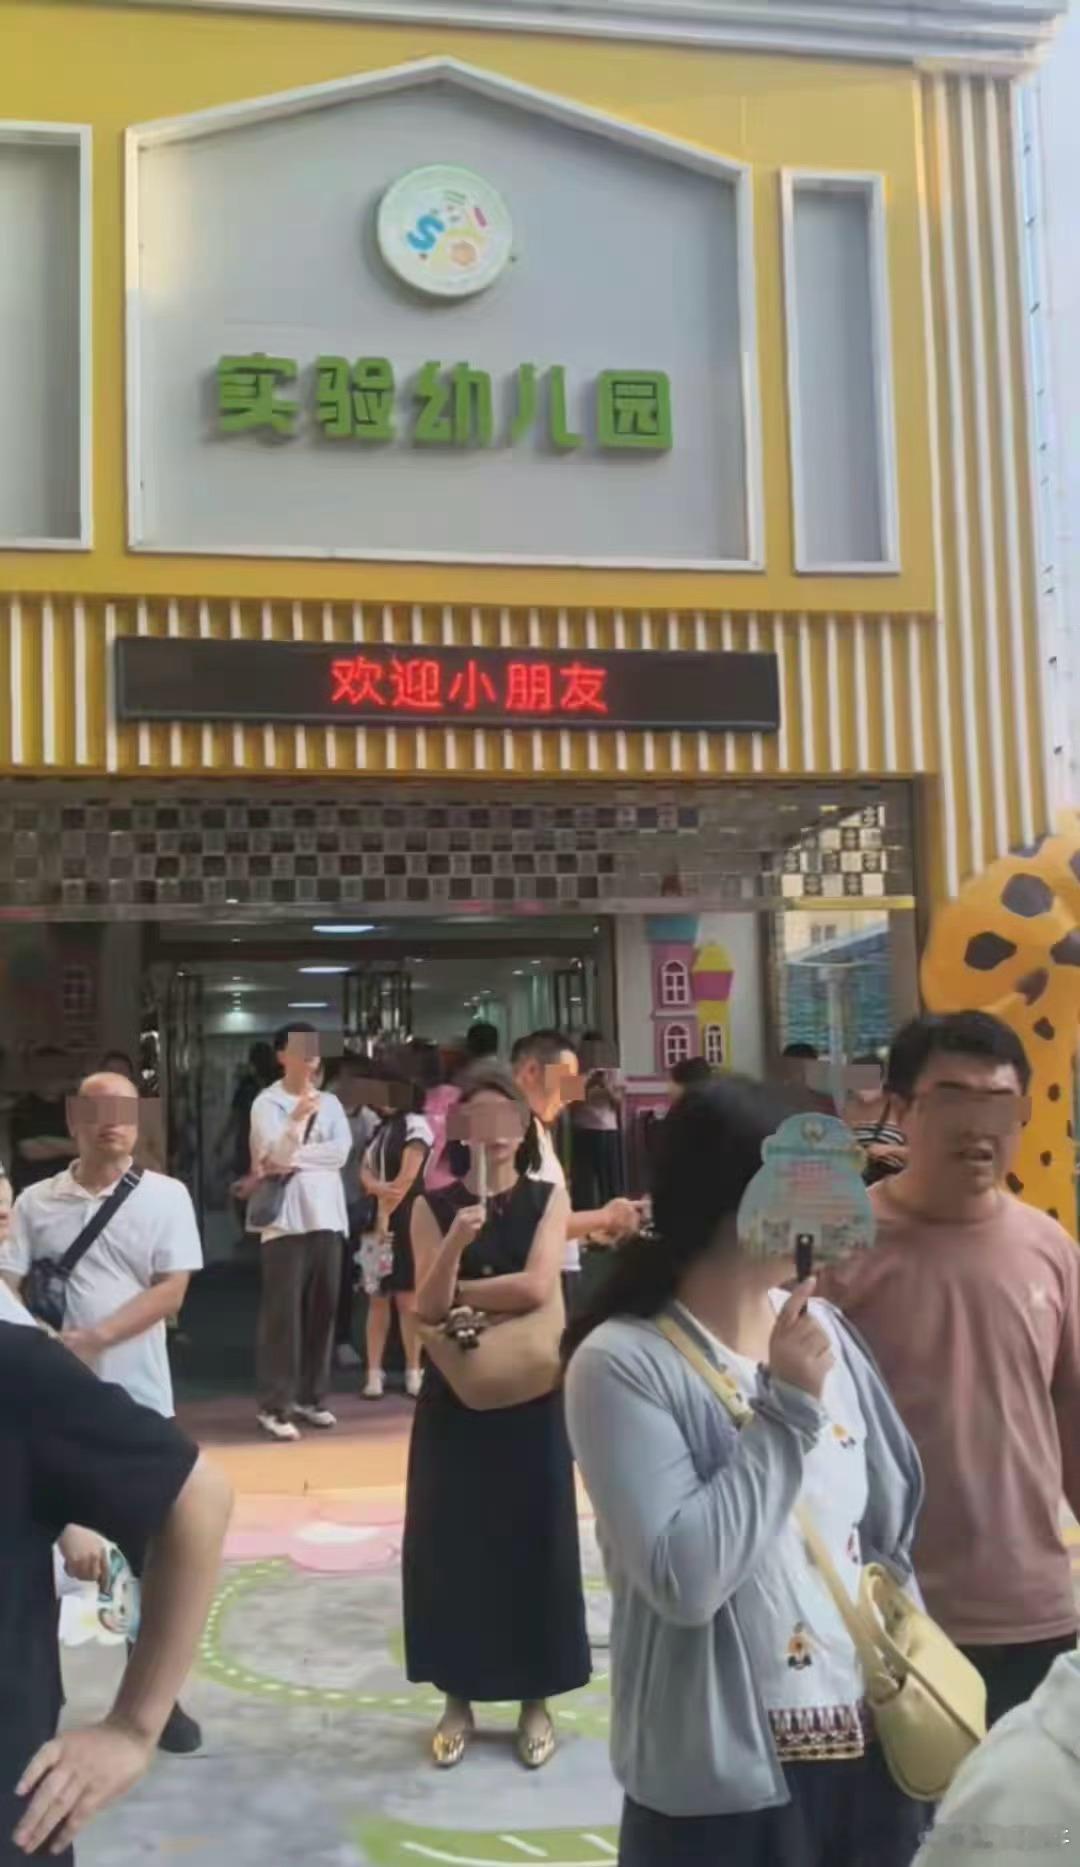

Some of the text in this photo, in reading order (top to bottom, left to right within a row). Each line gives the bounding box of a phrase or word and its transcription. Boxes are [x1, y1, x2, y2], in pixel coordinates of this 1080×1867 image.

[216, 353, 673, 453] 实验幼儿园
[330, 655, 609, 714] 欢迎小朋友
